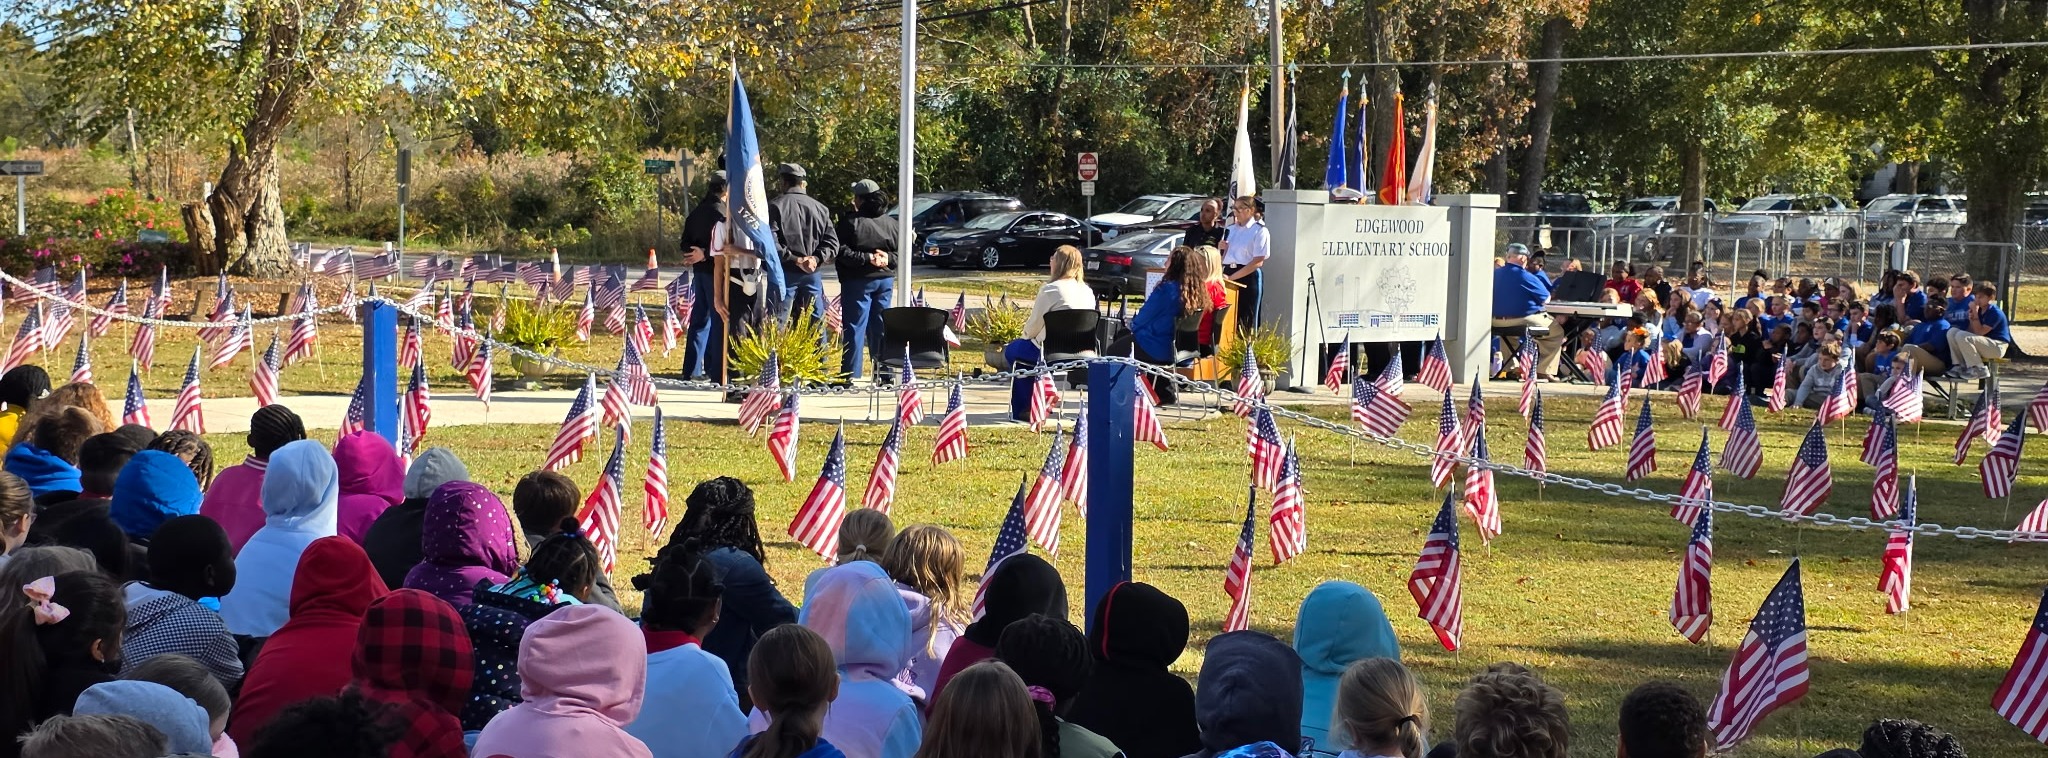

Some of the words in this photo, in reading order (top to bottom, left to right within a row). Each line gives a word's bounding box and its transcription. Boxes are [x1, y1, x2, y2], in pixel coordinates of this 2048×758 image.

[738, 206, 760, 230] 1775
[1355, 219, 1424, 235] EDGEWOOD
[1322, 242, 1405, 256] ELEMENTARY
[1409, 242, 1455, 256] SCHOOL
